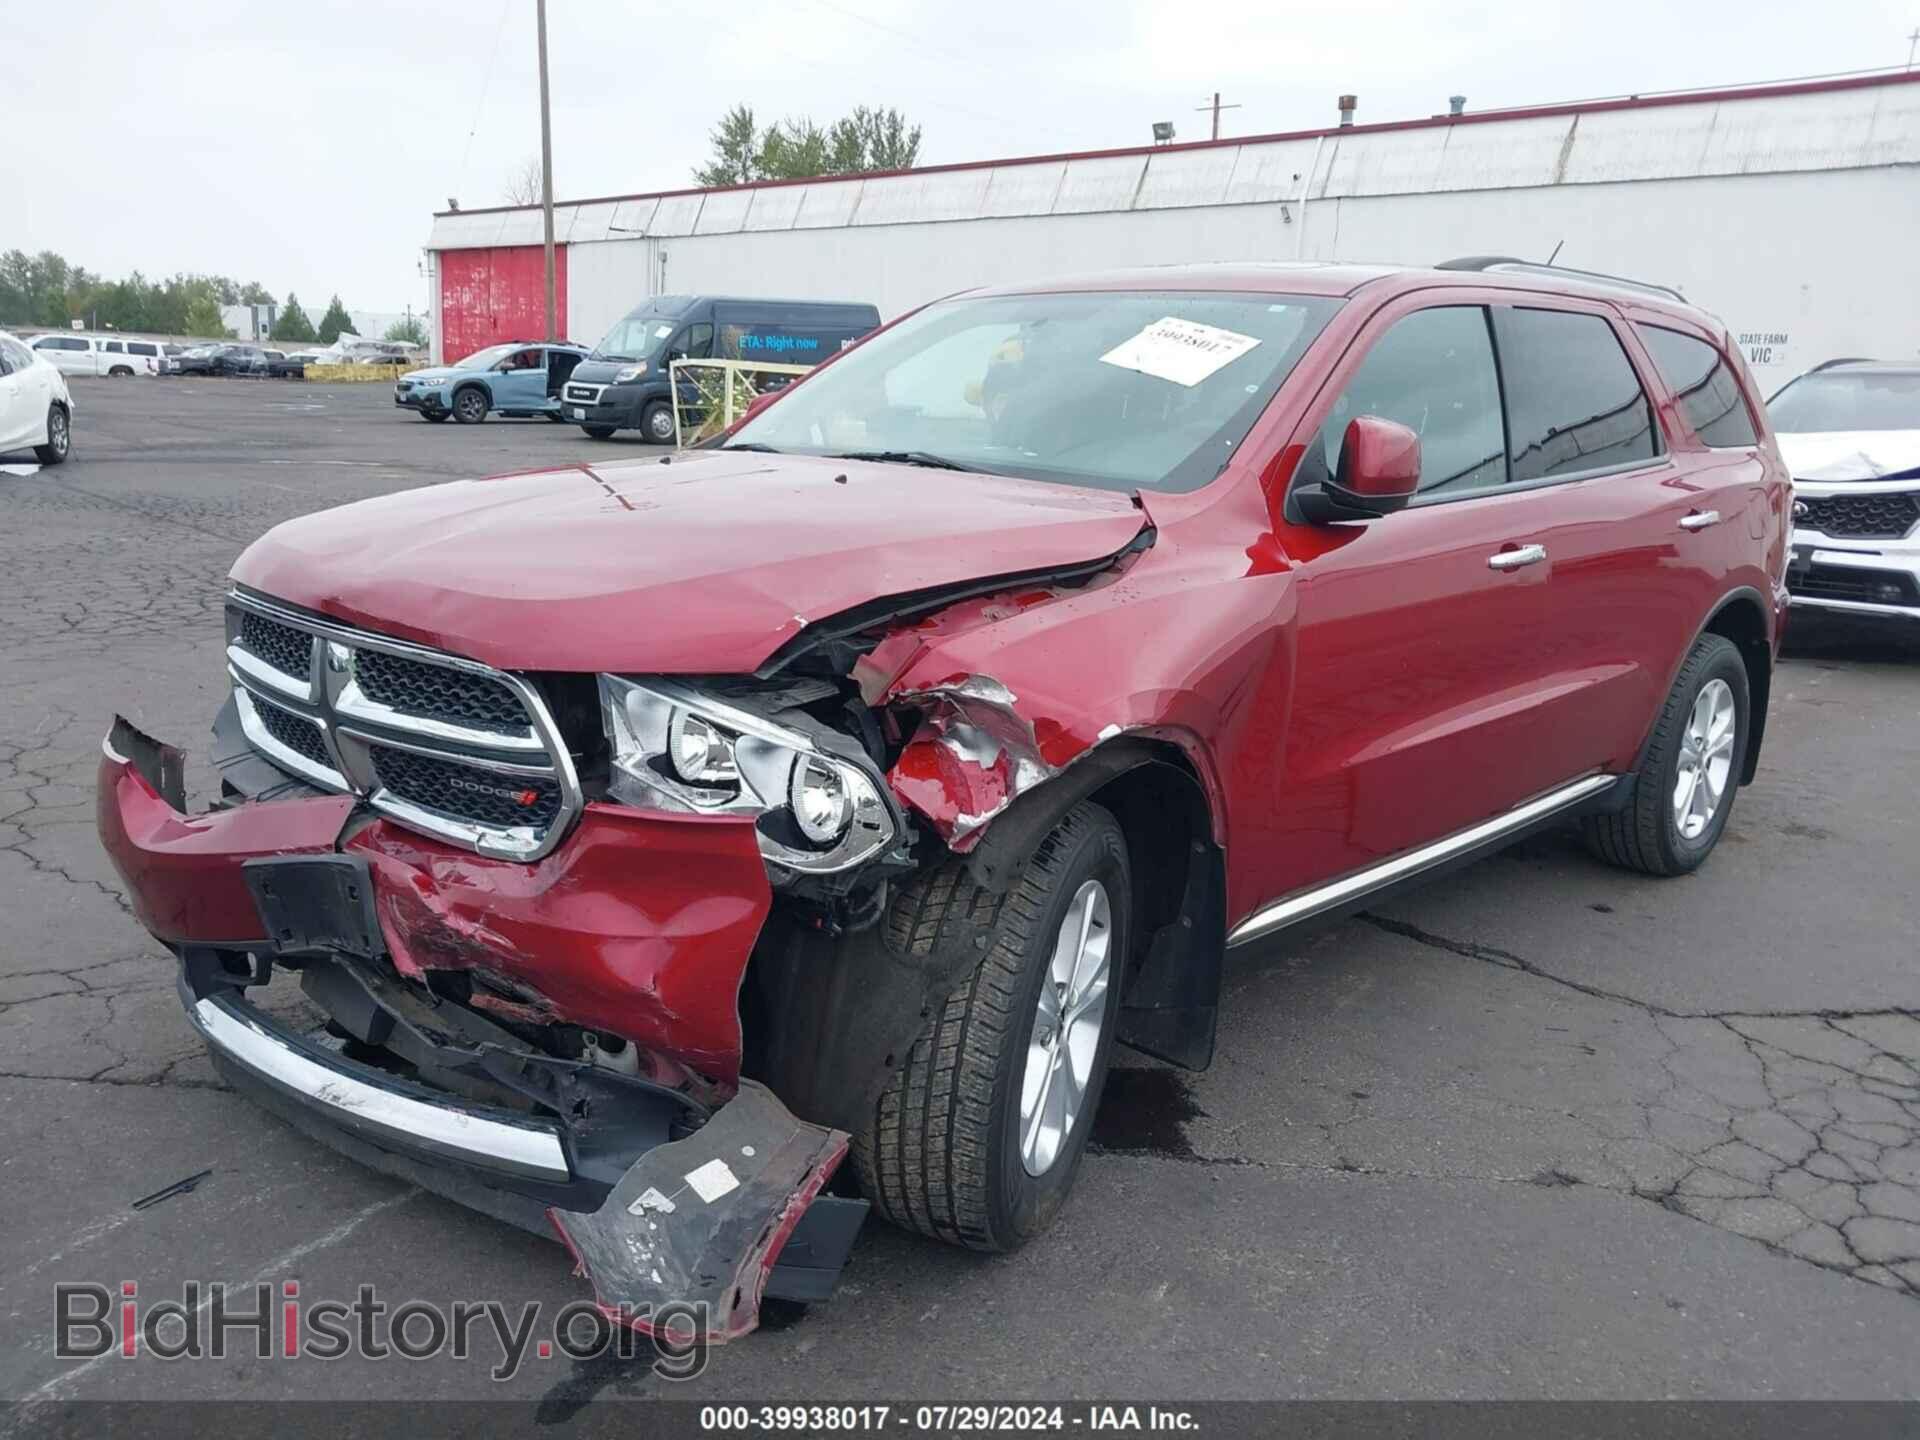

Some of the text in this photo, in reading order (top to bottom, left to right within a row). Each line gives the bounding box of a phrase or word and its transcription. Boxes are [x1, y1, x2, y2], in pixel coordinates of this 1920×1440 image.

[738, 335, 818, 352] ETA: Right now
[1739, 333, 1788, 345] STATE FARM
[1751, 347, 1772, 363] VIC
[450, 778, 524, 801] DODGE
